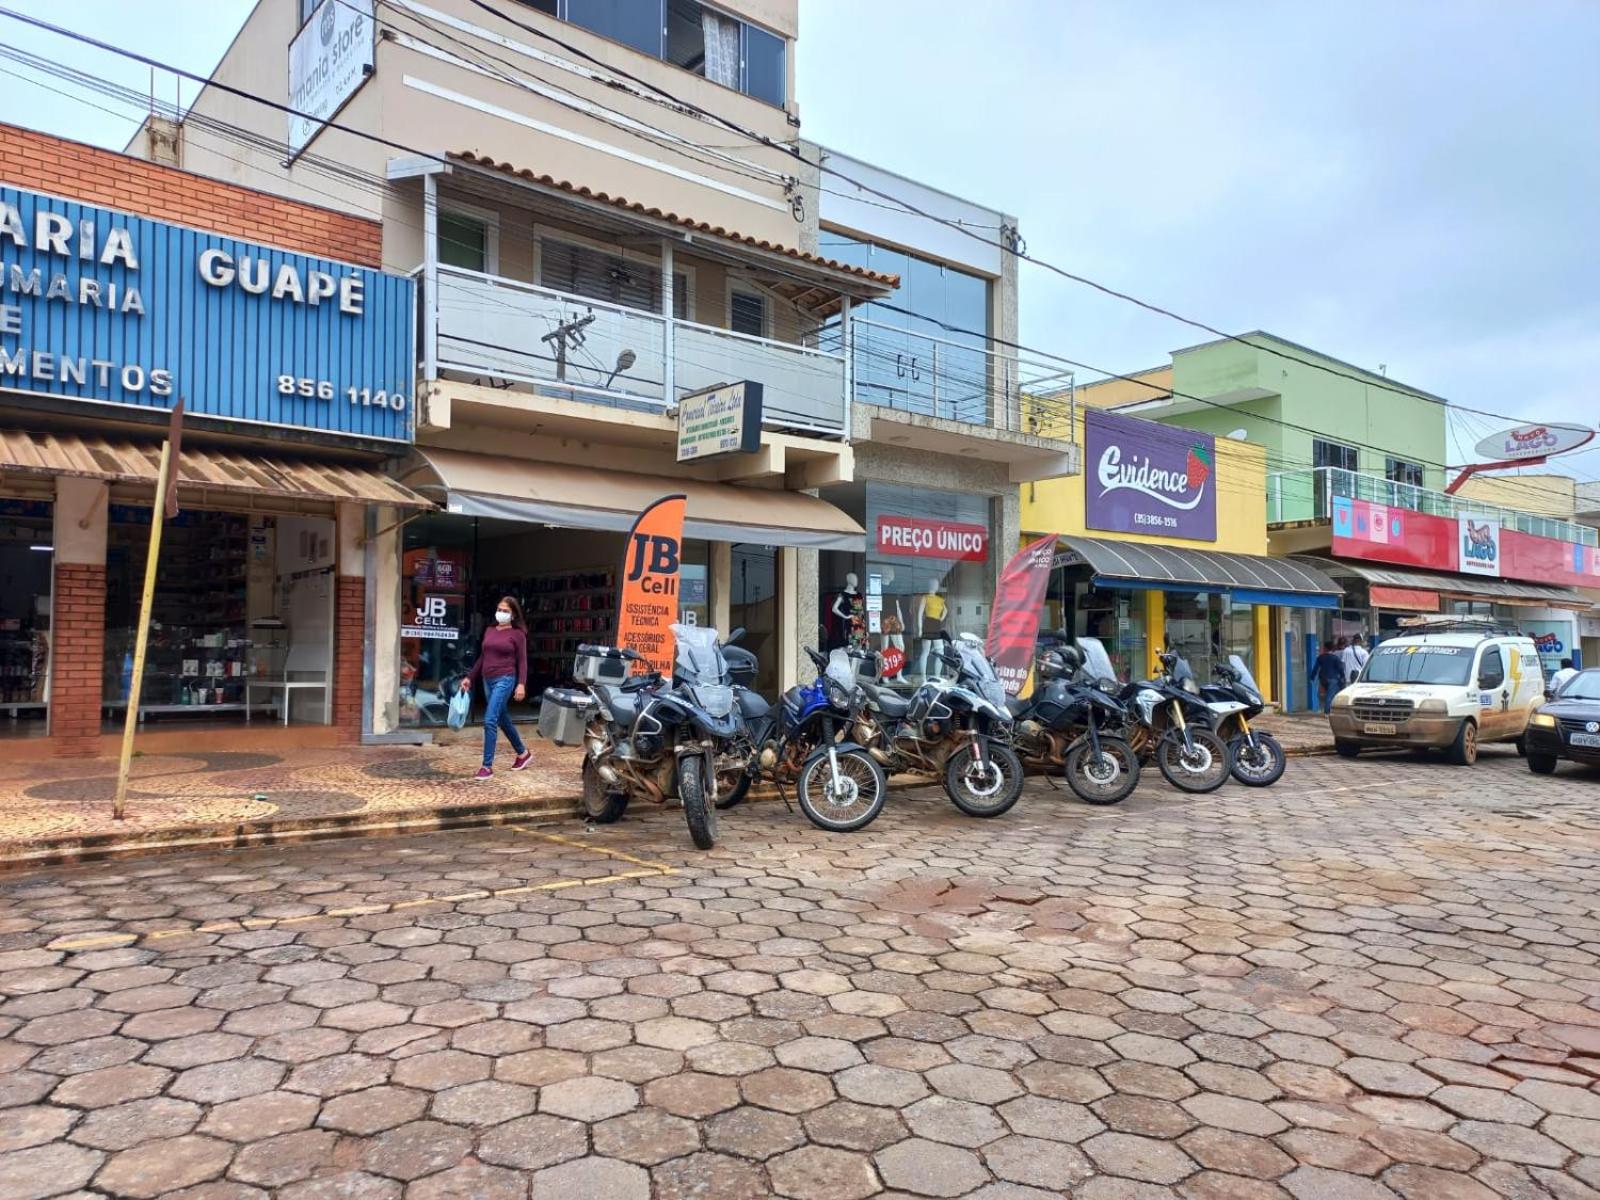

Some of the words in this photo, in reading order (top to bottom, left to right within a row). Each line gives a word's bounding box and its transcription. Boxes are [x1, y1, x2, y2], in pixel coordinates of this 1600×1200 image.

[296, 55, 328, 109] mania
[333, 15, 364, 65] store
[0, 262, 146, 316] MARIA
[199, 248, 364, 315] GUAPÉ
[277, 375, 335, 401] 856
[347, 386, 406, 412] 1140
[1098, 446, 1188, 495] Evidence
[628, 532, 679, 581] JB
[881, 525, 933, 552] PREÇO
[937, 527, 983, 553] ÚNICO
[641, 576, 675, 596] Cell
[414, 616, 447, 626] CELL
[416, 596, 447, 617] JB
[631, 613, 659, 627] TÉCNICA
